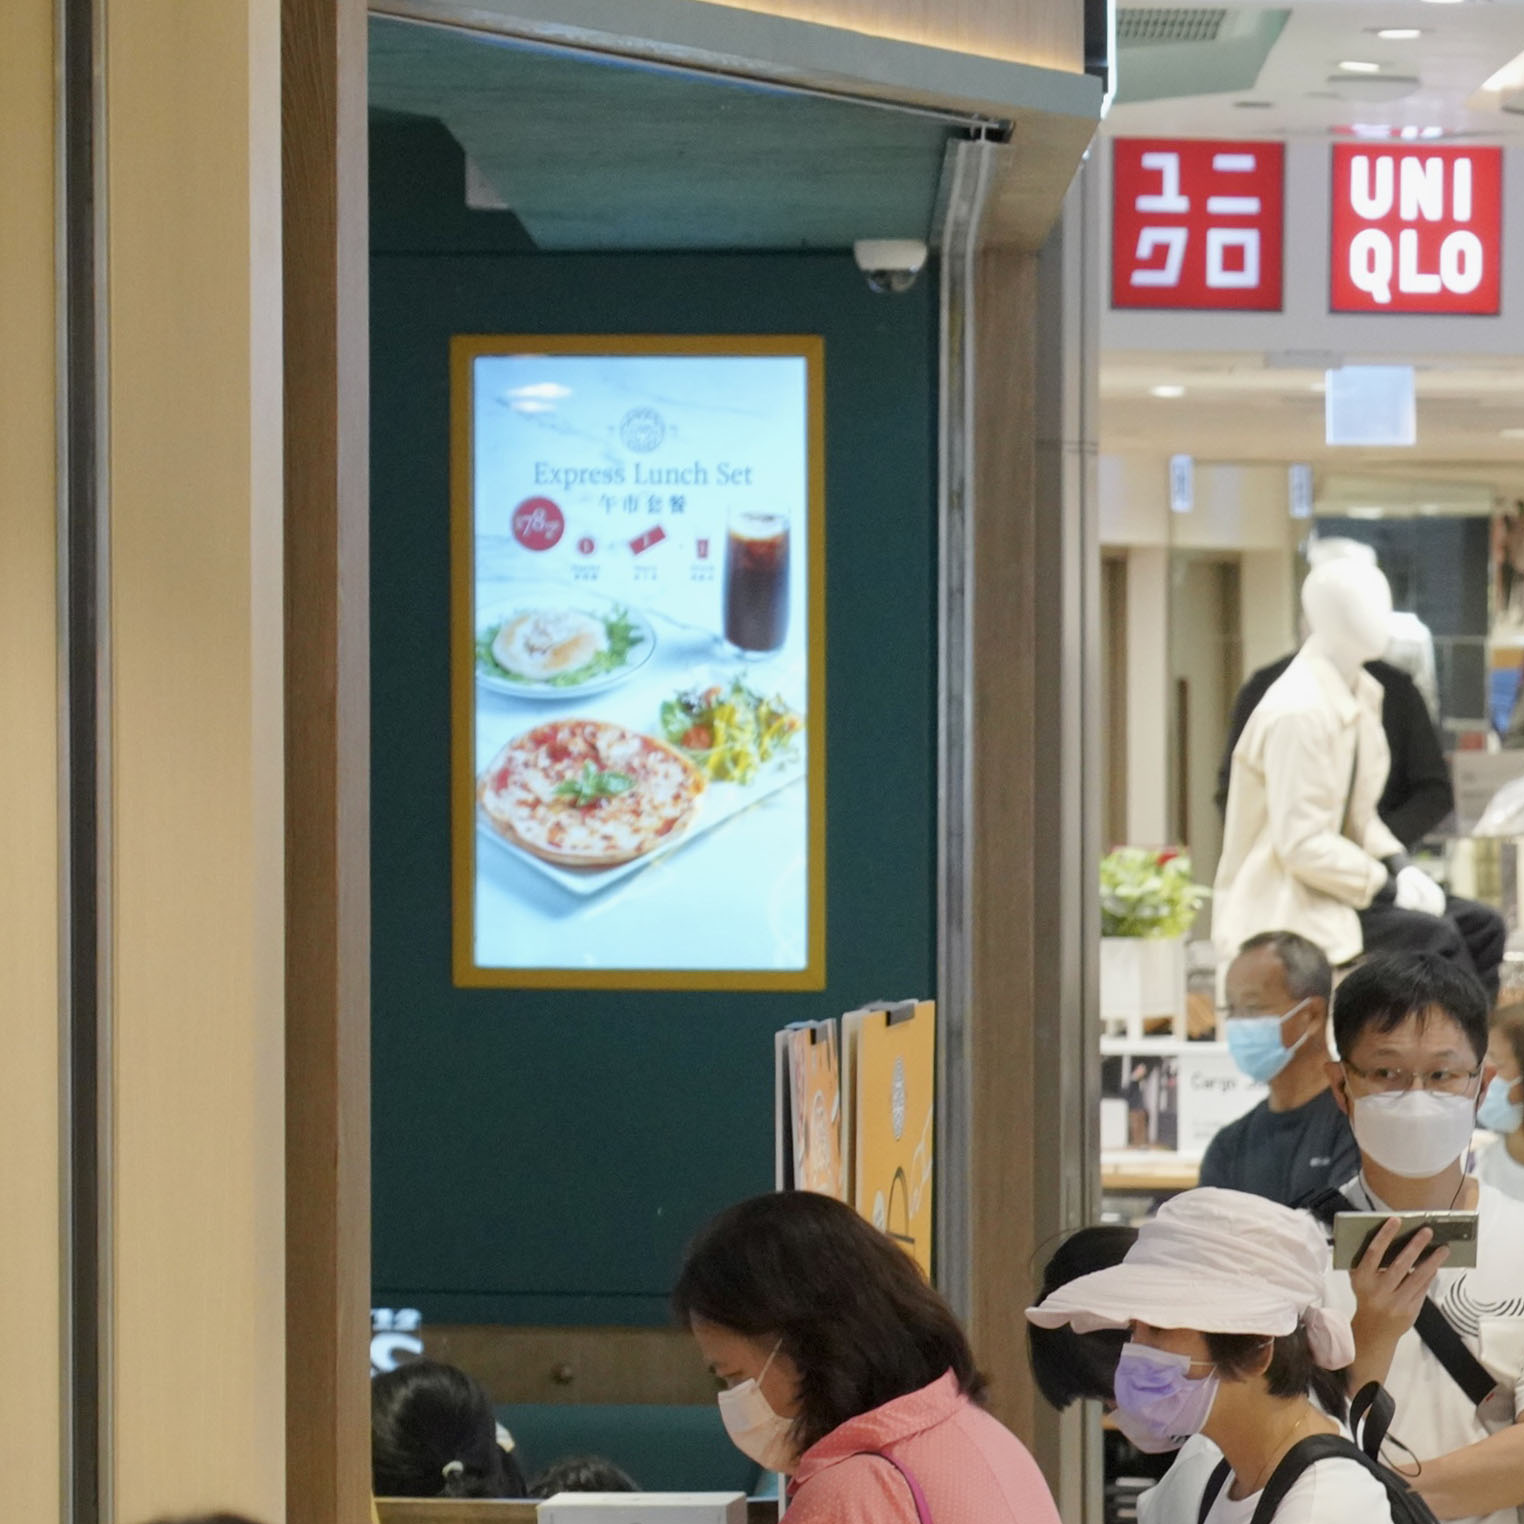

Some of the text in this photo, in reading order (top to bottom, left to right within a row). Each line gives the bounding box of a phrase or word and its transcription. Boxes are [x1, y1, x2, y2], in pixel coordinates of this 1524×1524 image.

[1350, 155, 1472, 222] UNI
[1349, 228, 1484, 304] QLO
[534, 460, 753, 491] Express Lunch Set
[600, 494, 687, 515] 午市套餐
